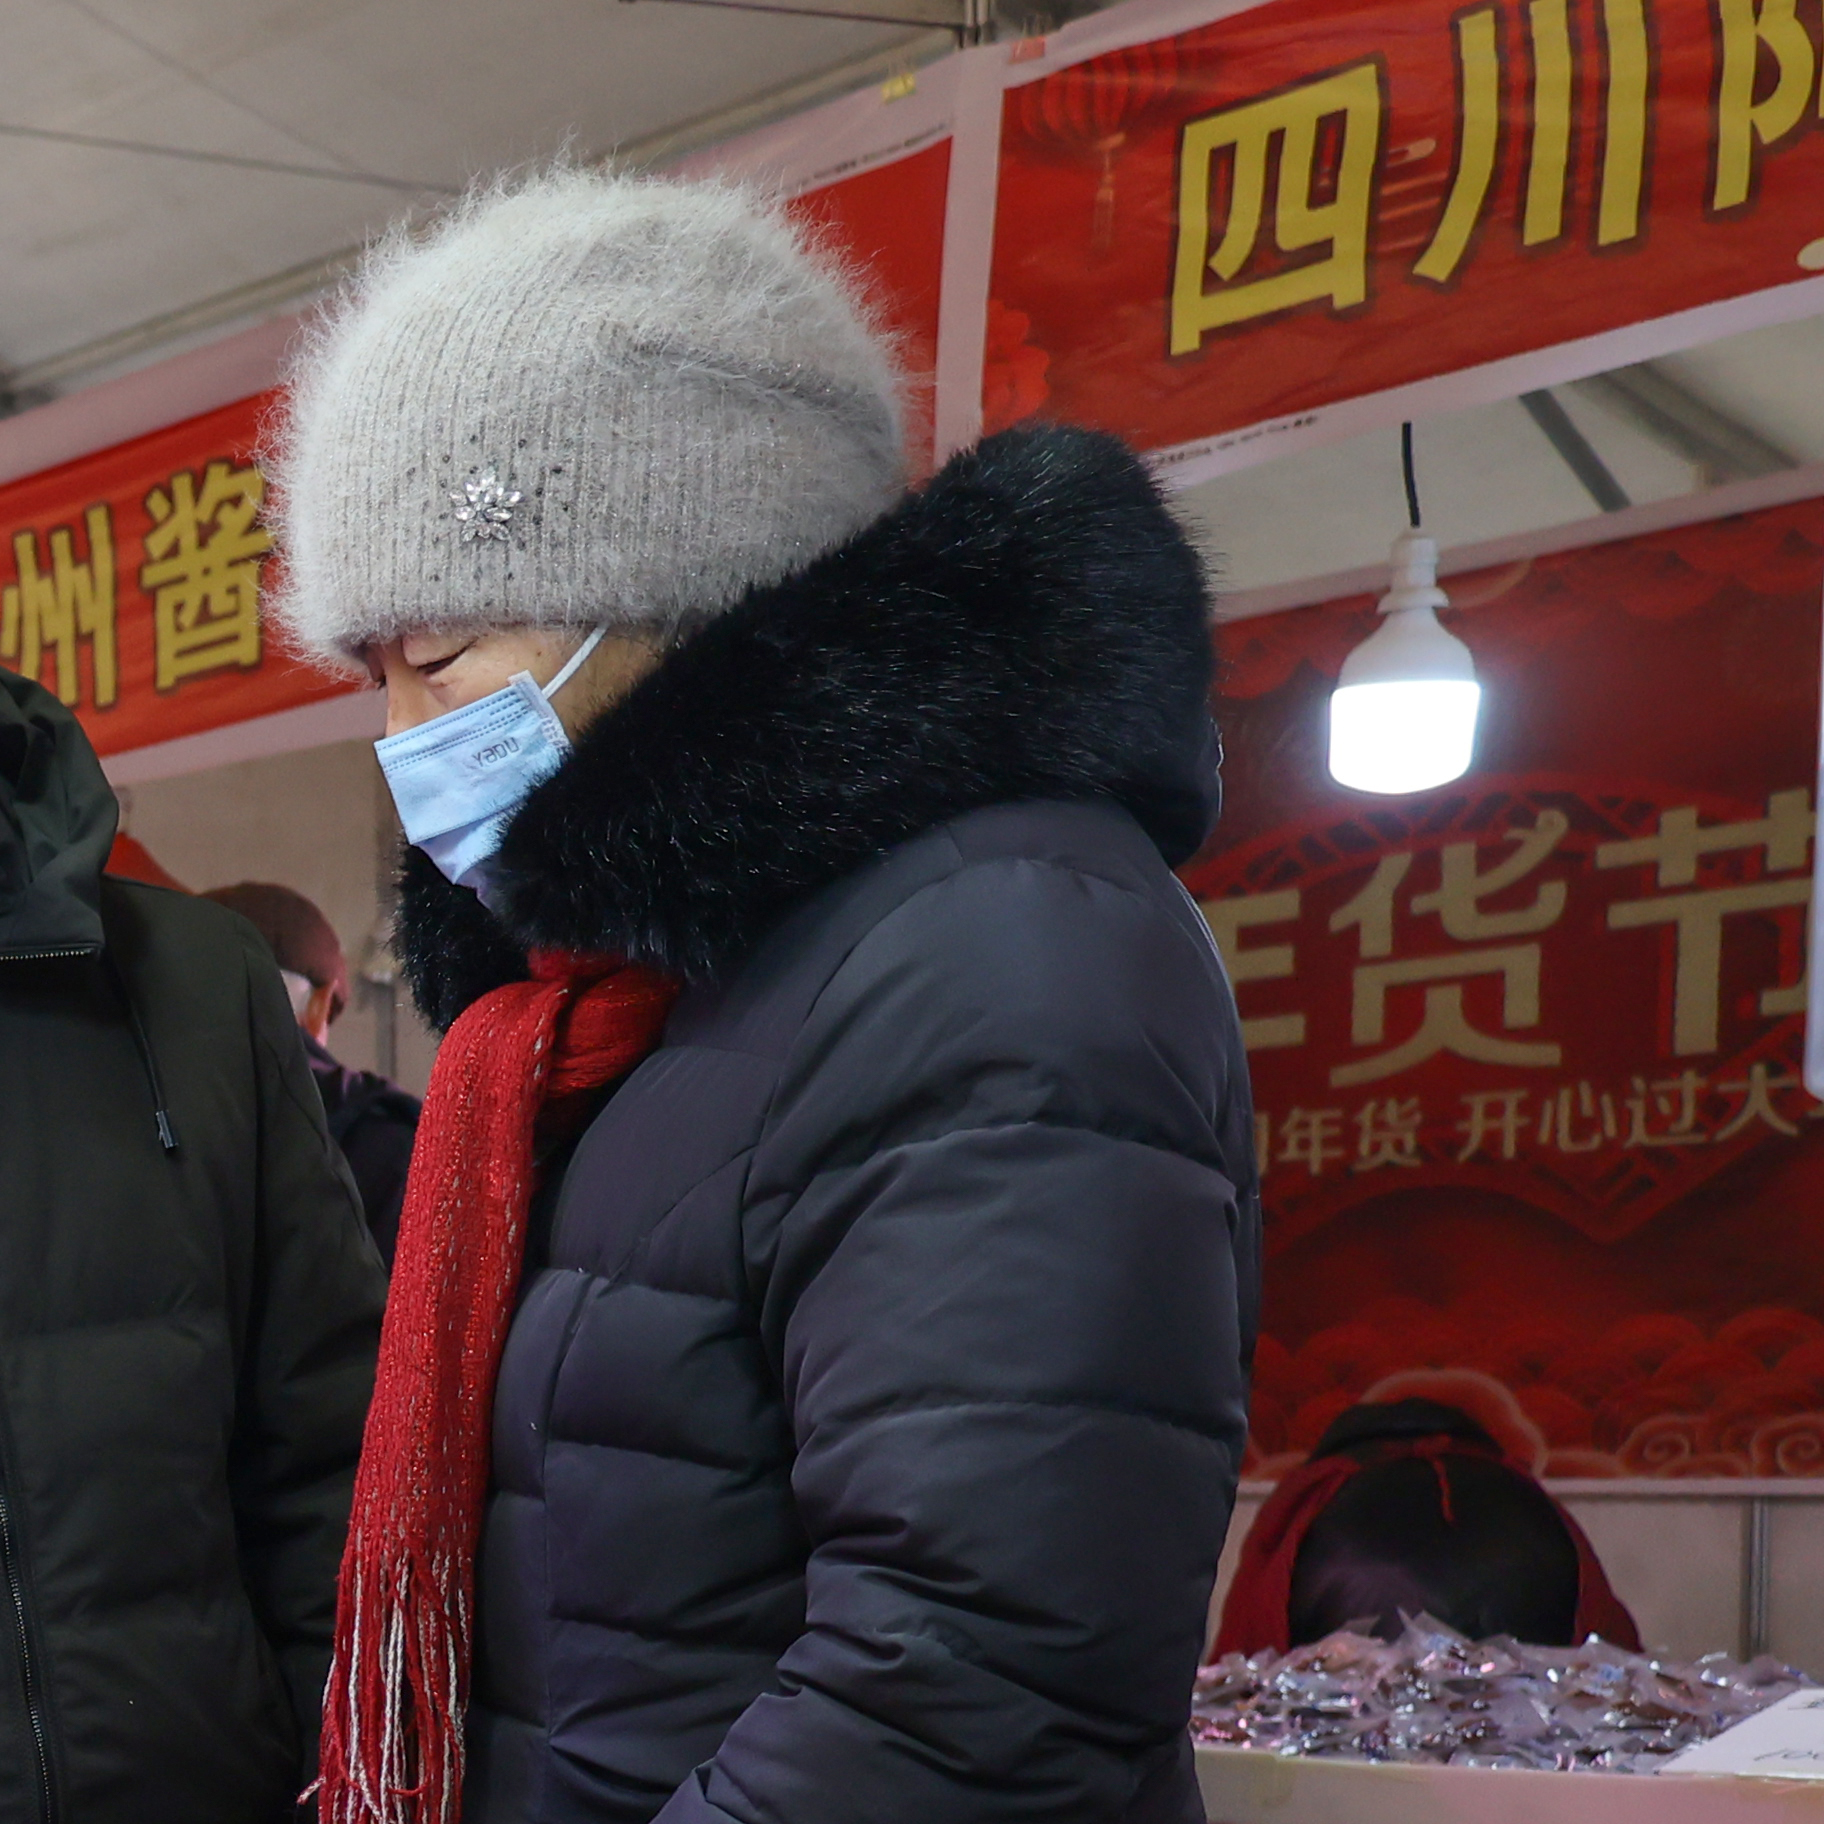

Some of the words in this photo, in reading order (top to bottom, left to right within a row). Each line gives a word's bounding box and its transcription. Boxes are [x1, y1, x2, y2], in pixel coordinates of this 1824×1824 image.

[1254, 1100, 1422, 1175] 年货
[1457, 1062, 1824, 1165] 开心过大
